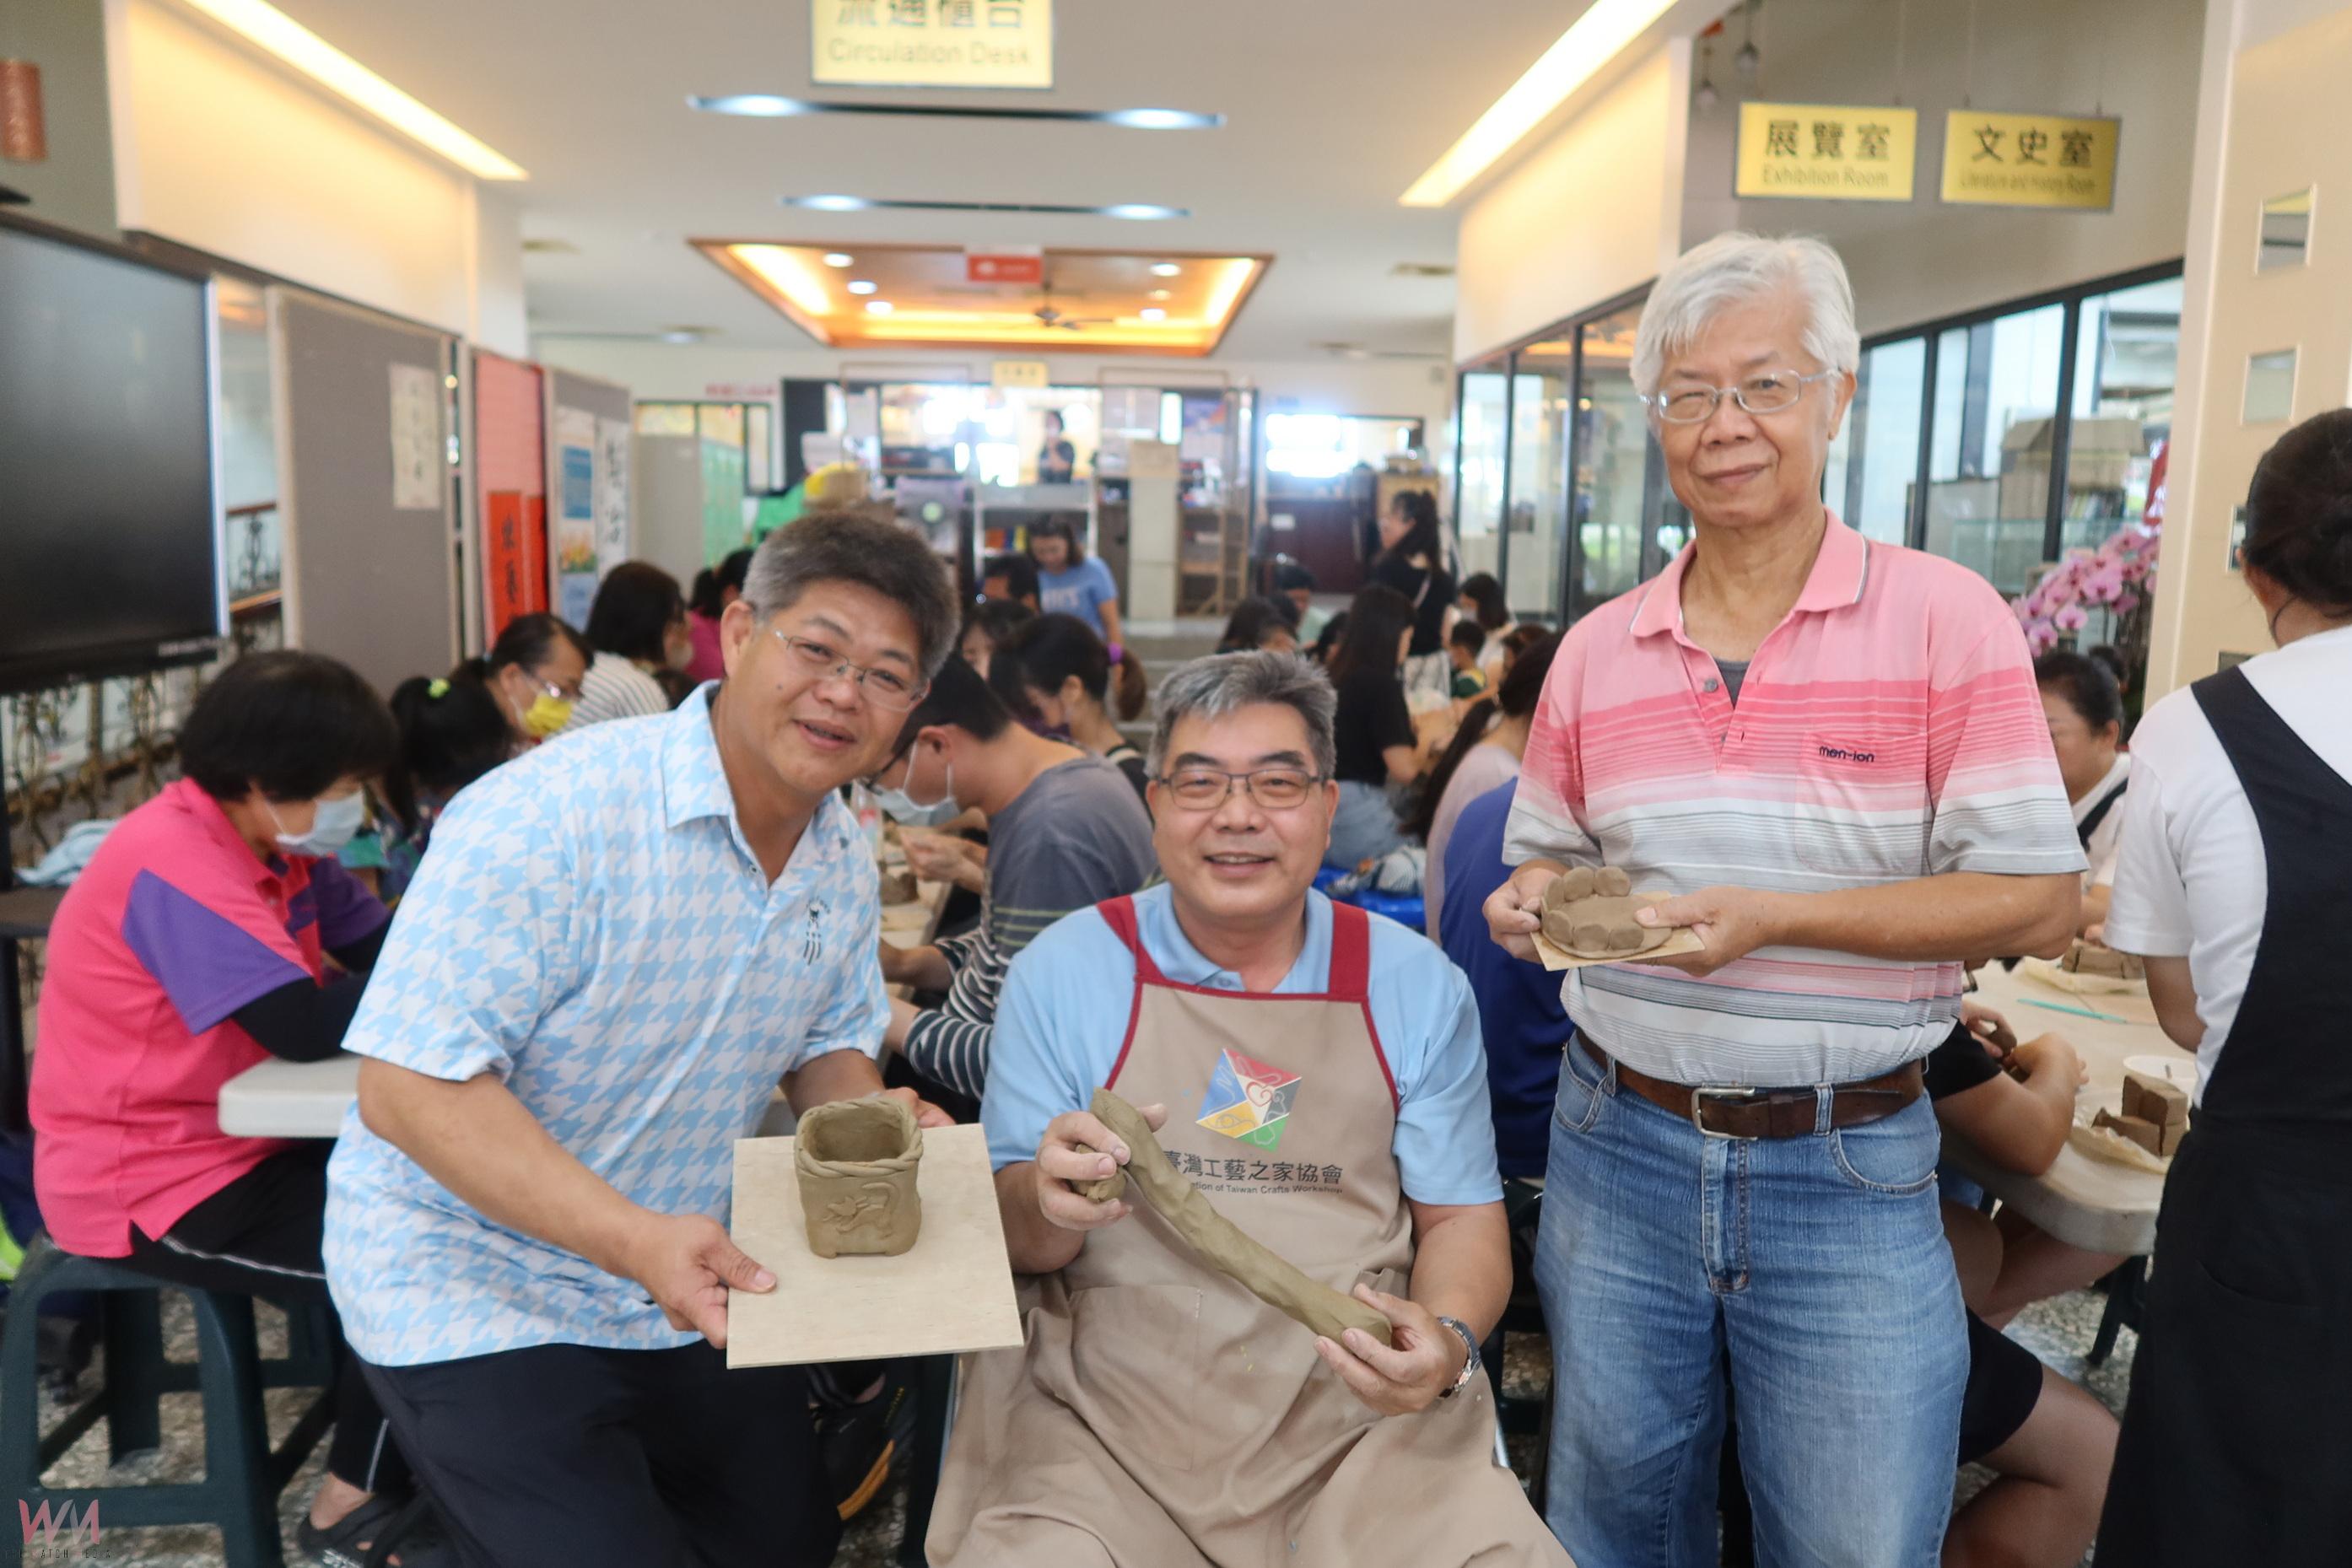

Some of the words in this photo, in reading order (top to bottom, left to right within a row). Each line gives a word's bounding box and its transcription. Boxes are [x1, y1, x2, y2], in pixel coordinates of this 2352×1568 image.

[827, 37, 963, 64] Circulation
[970, 40, 1031, 66] Desk
[1765, 120, 1891, 160] 展覽室
[1971, 123, 2094, 168] 文史室
[1762, 163, 1840, 186] Exhibition
[1843, 165, 1890, 188] Room
[1215, 1183, 1224, 1192] of
[1227, 1184, 1258, 1194] Taiwan
[1260, 1185, 1290, 1194] Crafts
